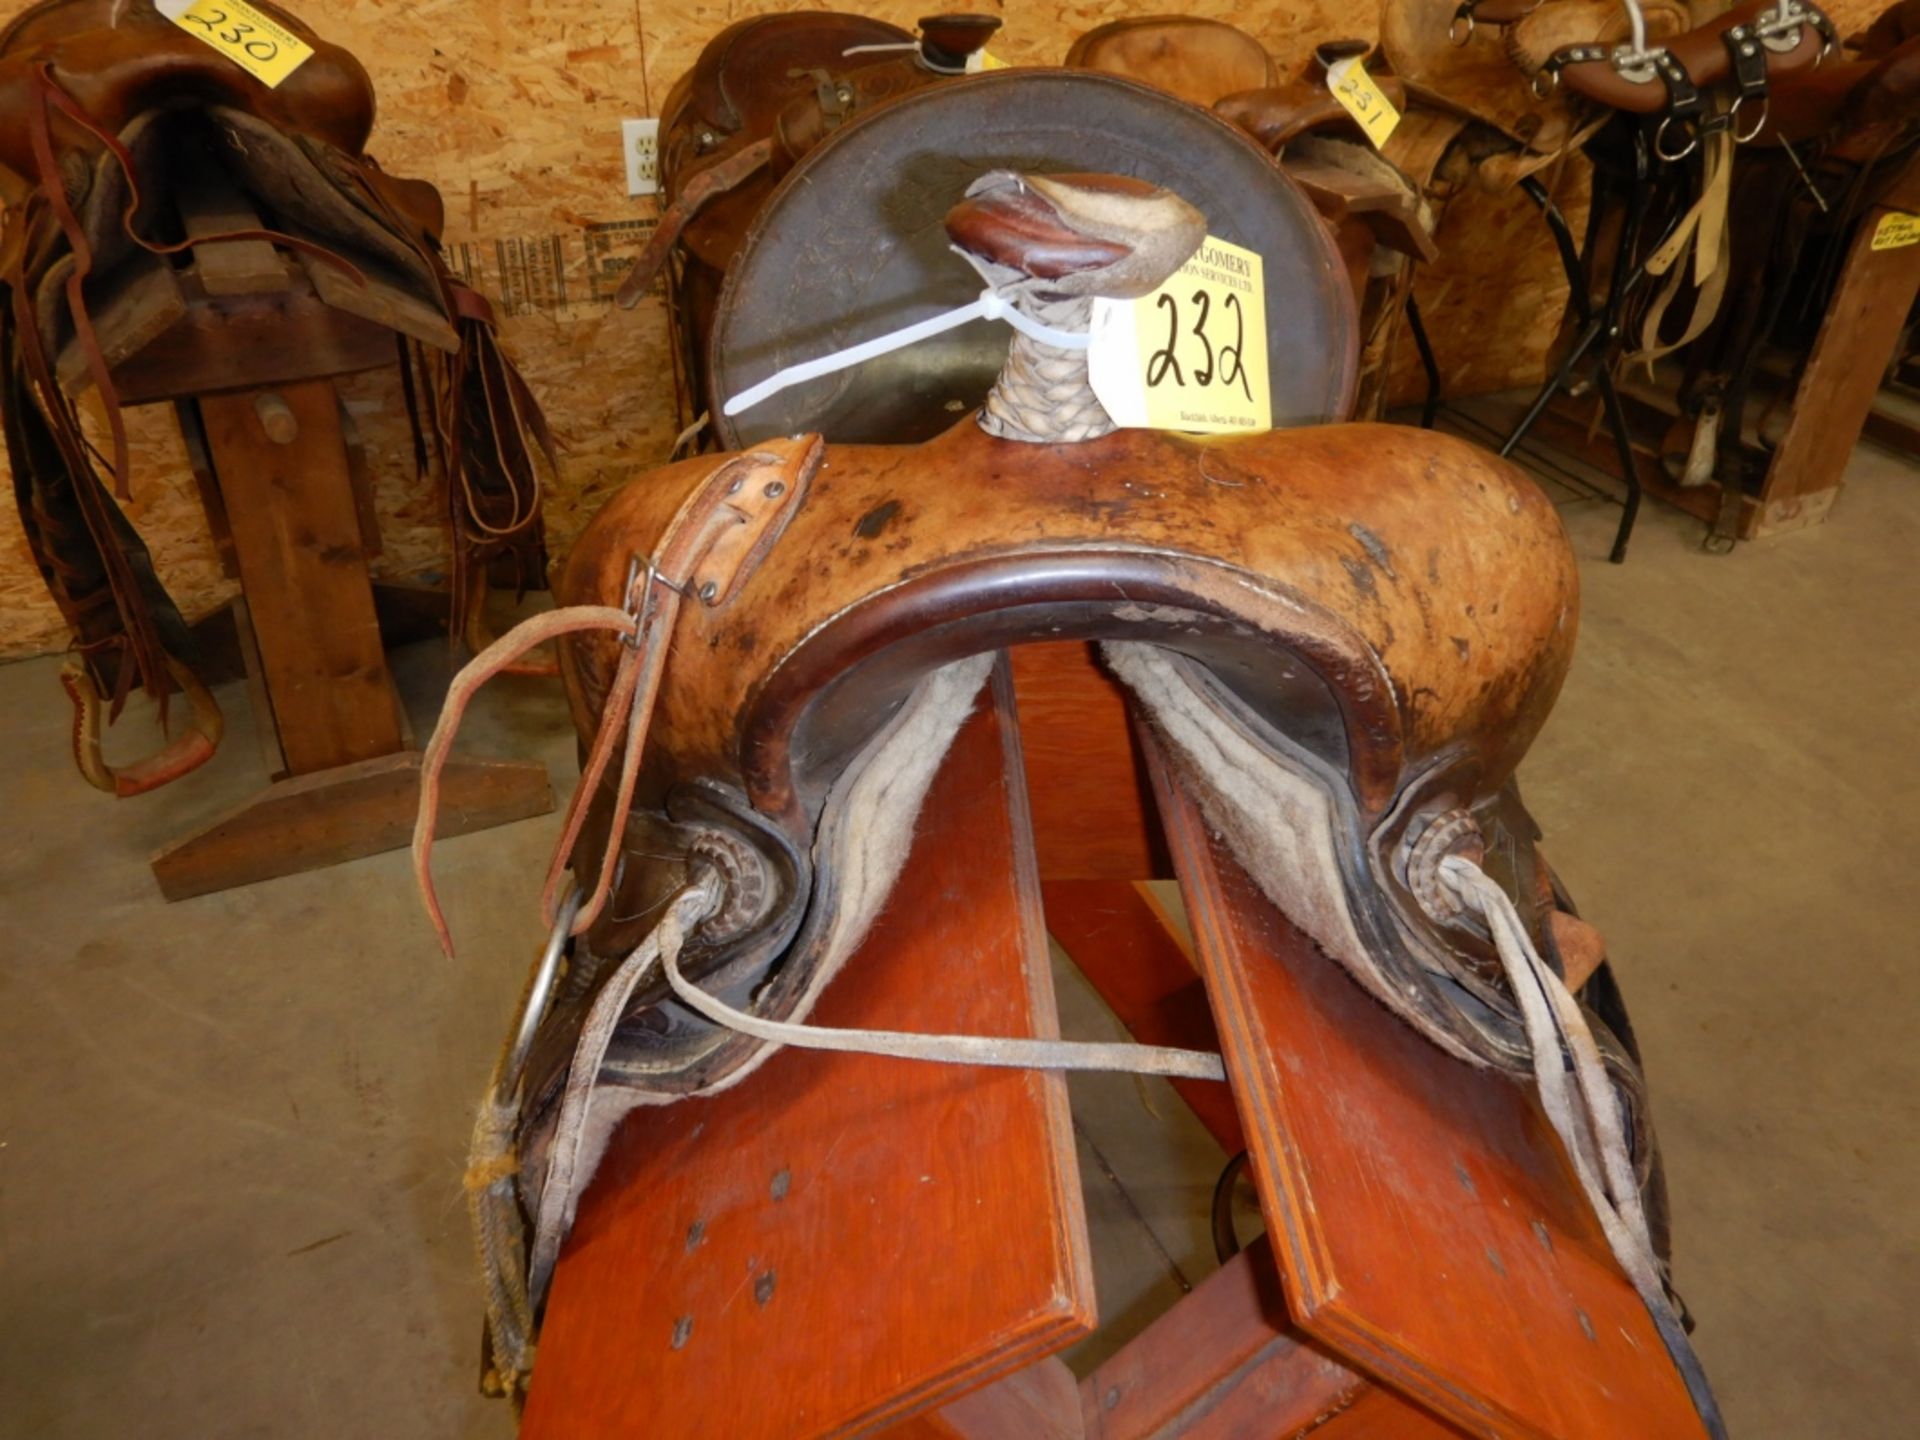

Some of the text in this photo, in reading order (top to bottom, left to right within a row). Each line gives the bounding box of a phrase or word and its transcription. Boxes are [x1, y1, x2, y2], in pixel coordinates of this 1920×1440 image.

[184, 8, 279, 62] 230
[1339, 79, 1383, 125] 231
[1193, 246, 1252, 277] GOMERY
[1146, 289, 1254, 403] 232
